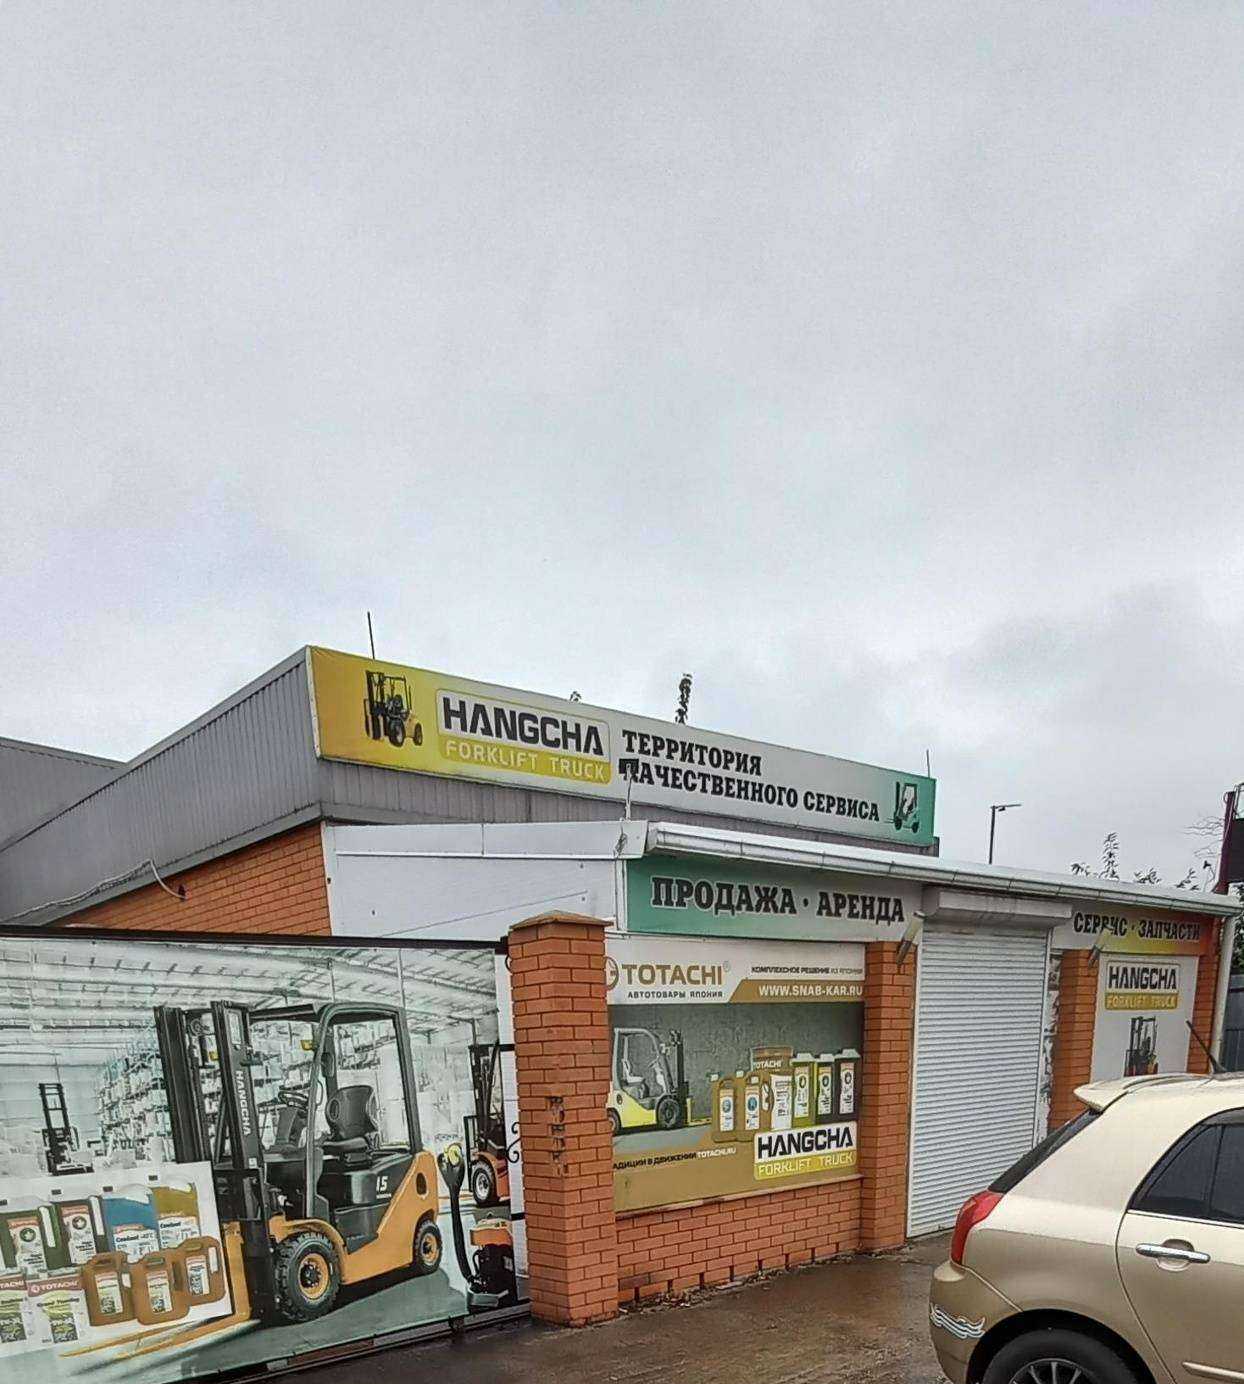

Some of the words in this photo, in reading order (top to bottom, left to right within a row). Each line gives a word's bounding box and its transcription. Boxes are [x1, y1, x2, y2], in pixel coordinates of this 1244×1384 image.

[442, 696, 604, 757] HANGCHA
[446, 741, 539, 771] FORKLIFT
[550, 756, 605, 781] TRUCK
[622, 730, 762, 776] ТЕРРИТОРИЯ
[803, 791, 880, 822] СЕРВИСА
[651, 876, 797, 917] ПРОДАЖА
[816, 891, 904, 926] АРЕНДА
[1138, 920, 1200, 941] ЗАПЧАСТИ
[621, 964, 723, 986] TOTACHI
[1107, 965, 1178, 990] HANGCHA
[628, 990, 686, 999] АВТОТОВАРЫ
[759, 985, 863, 997] WWW.SNAB-KAR.RU
[235, 1070, 252, 1136] HANGCHA
[757, 1126, 854, 1160] HANGCHA
[613, 1159, 647, 1171] АДИЦИИ
[758, 1159, 812, 1177] FORKLIFT
[819, 1152, 854, 1169] TRUCK
